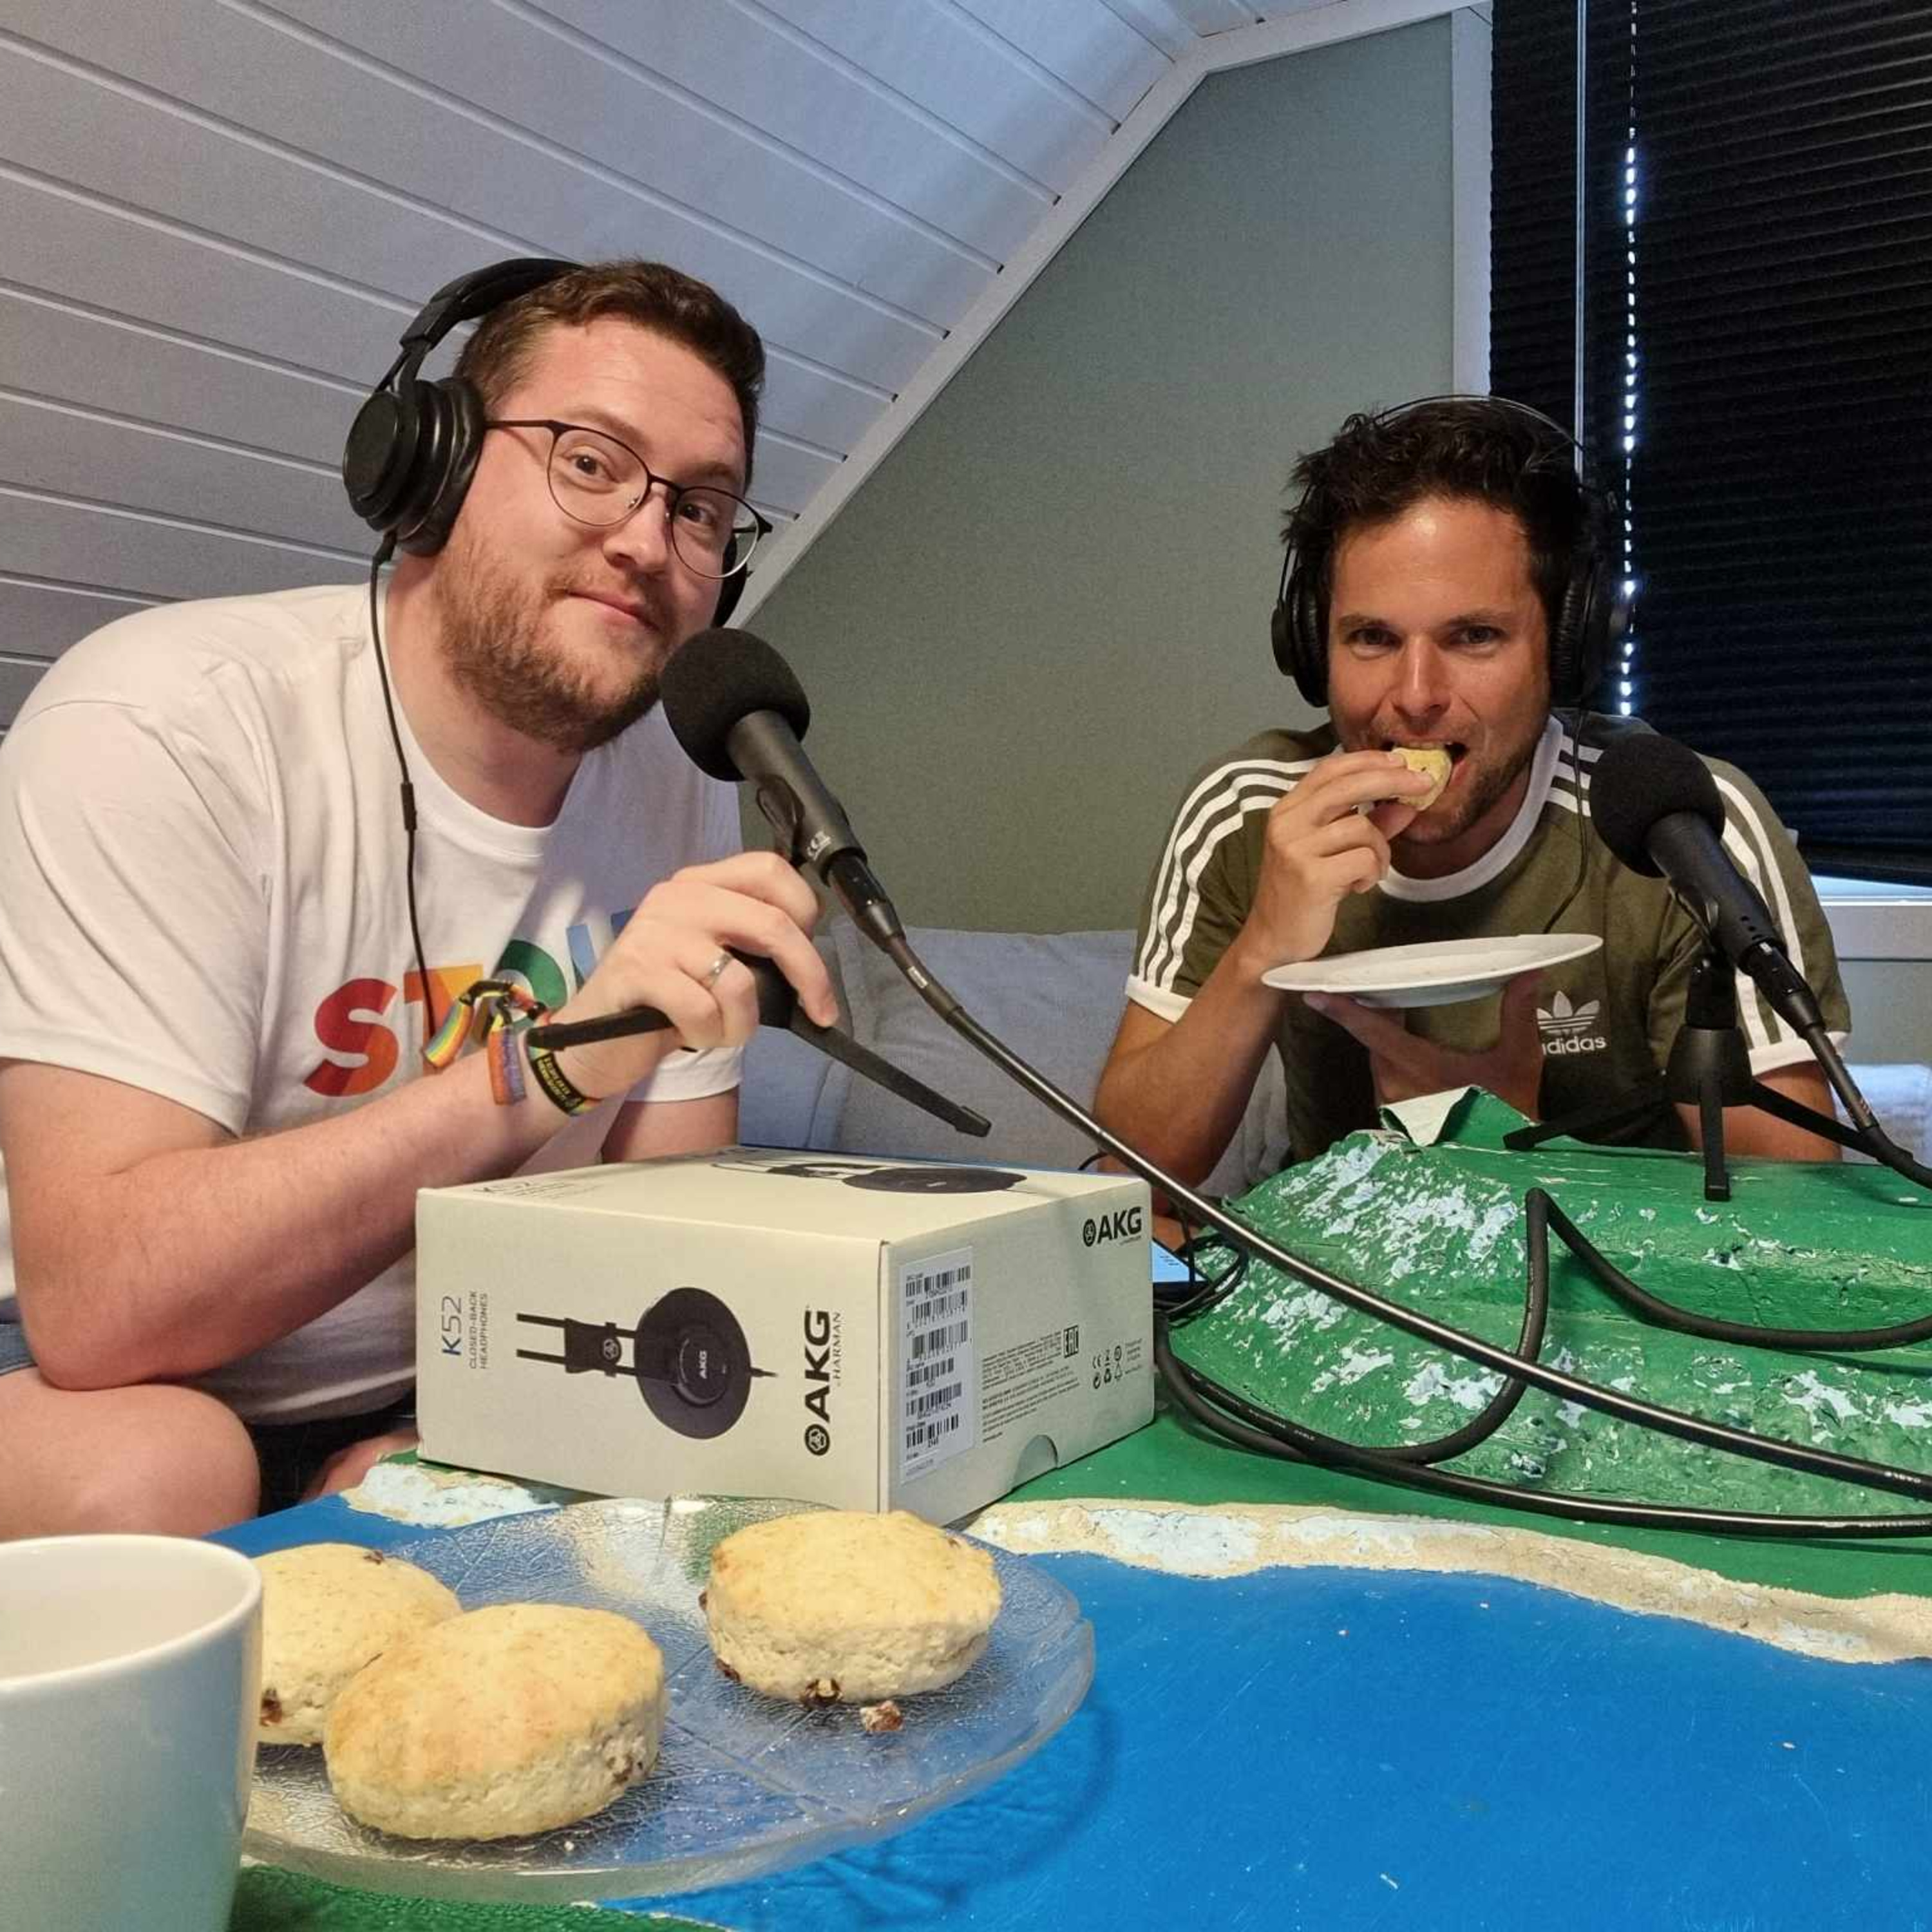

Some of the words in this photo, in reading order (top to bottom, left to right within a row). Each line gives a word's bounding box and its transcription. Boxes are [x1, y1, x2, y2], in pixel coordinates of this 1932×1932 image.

[1542, 1036, 1606, 1055] didas
[1097, 1207, 1142, 1244] AKG
[442, 1296, 462, 1355] K52
[469, 1291, 477, 1368] CLOSED-BACK
[479, 1293, 488, 1368] HEADPHONES
[833, 1311, 842, 1379] HARMAN
[699, 1350, 707, 1379] AKG
[804, 1310, 830, 1423] AKG
